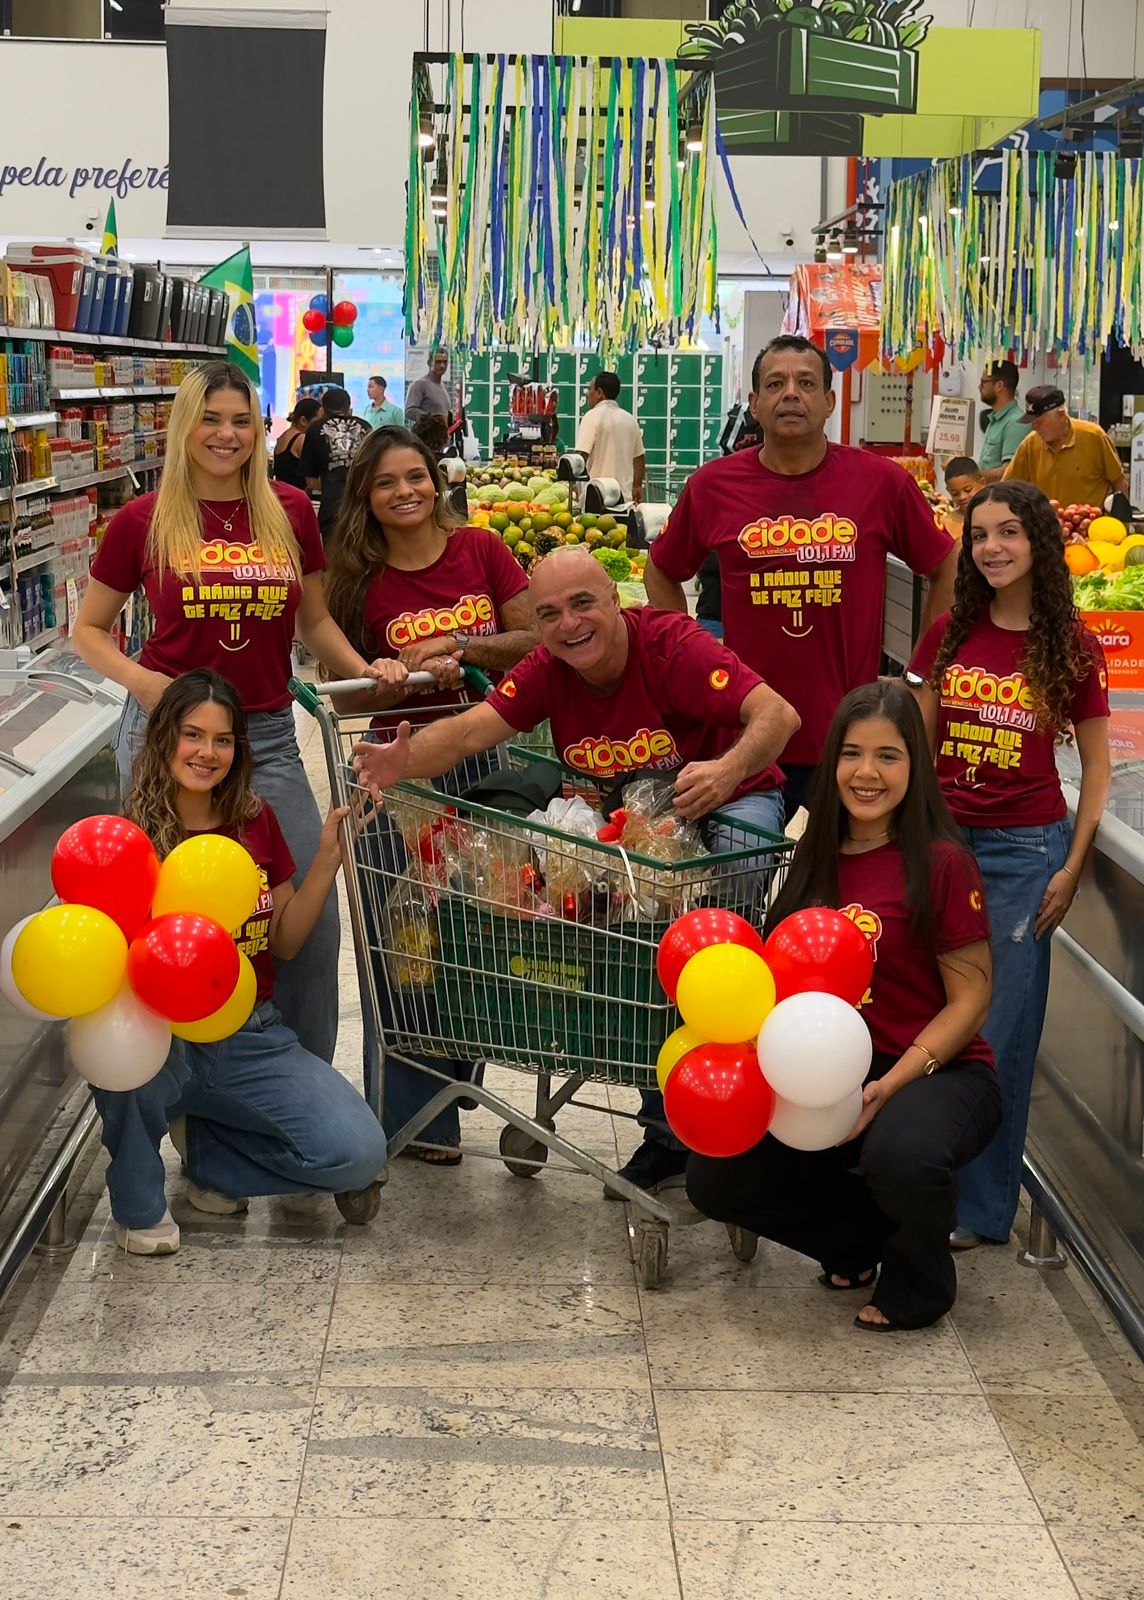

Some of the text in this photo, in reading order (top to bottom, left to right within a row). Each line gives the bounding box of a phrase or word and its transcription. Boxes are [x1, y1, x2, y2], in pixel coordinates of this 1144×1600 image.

[0, 156, 68, 197] pela
[939, 433, 960, 443] 25,98
[742, 517, 855, 548] cidade
[798, 545, 853, 560] 101,1 FM
[750, 569, 842, 588] A RÁDIO QUE
[182, 583, 288, 604] A RÁDIO QUE
[751, 589, 842, 608] TE FAZ FELIZ
[183, 603, 286, 620] TE FAZ FELIZ
[390, 598, 492, 645] cidade
[981, 703, 1033, 728] 101,1 FM
[949, 721, 993, 743] RÁDIO
[994, 729, 1023, 750] QUE
[569, 733, 672, 770] cidade
[956, 743, 983, 765] FAZ
[983, 747, 1021, 769] FELIZ
